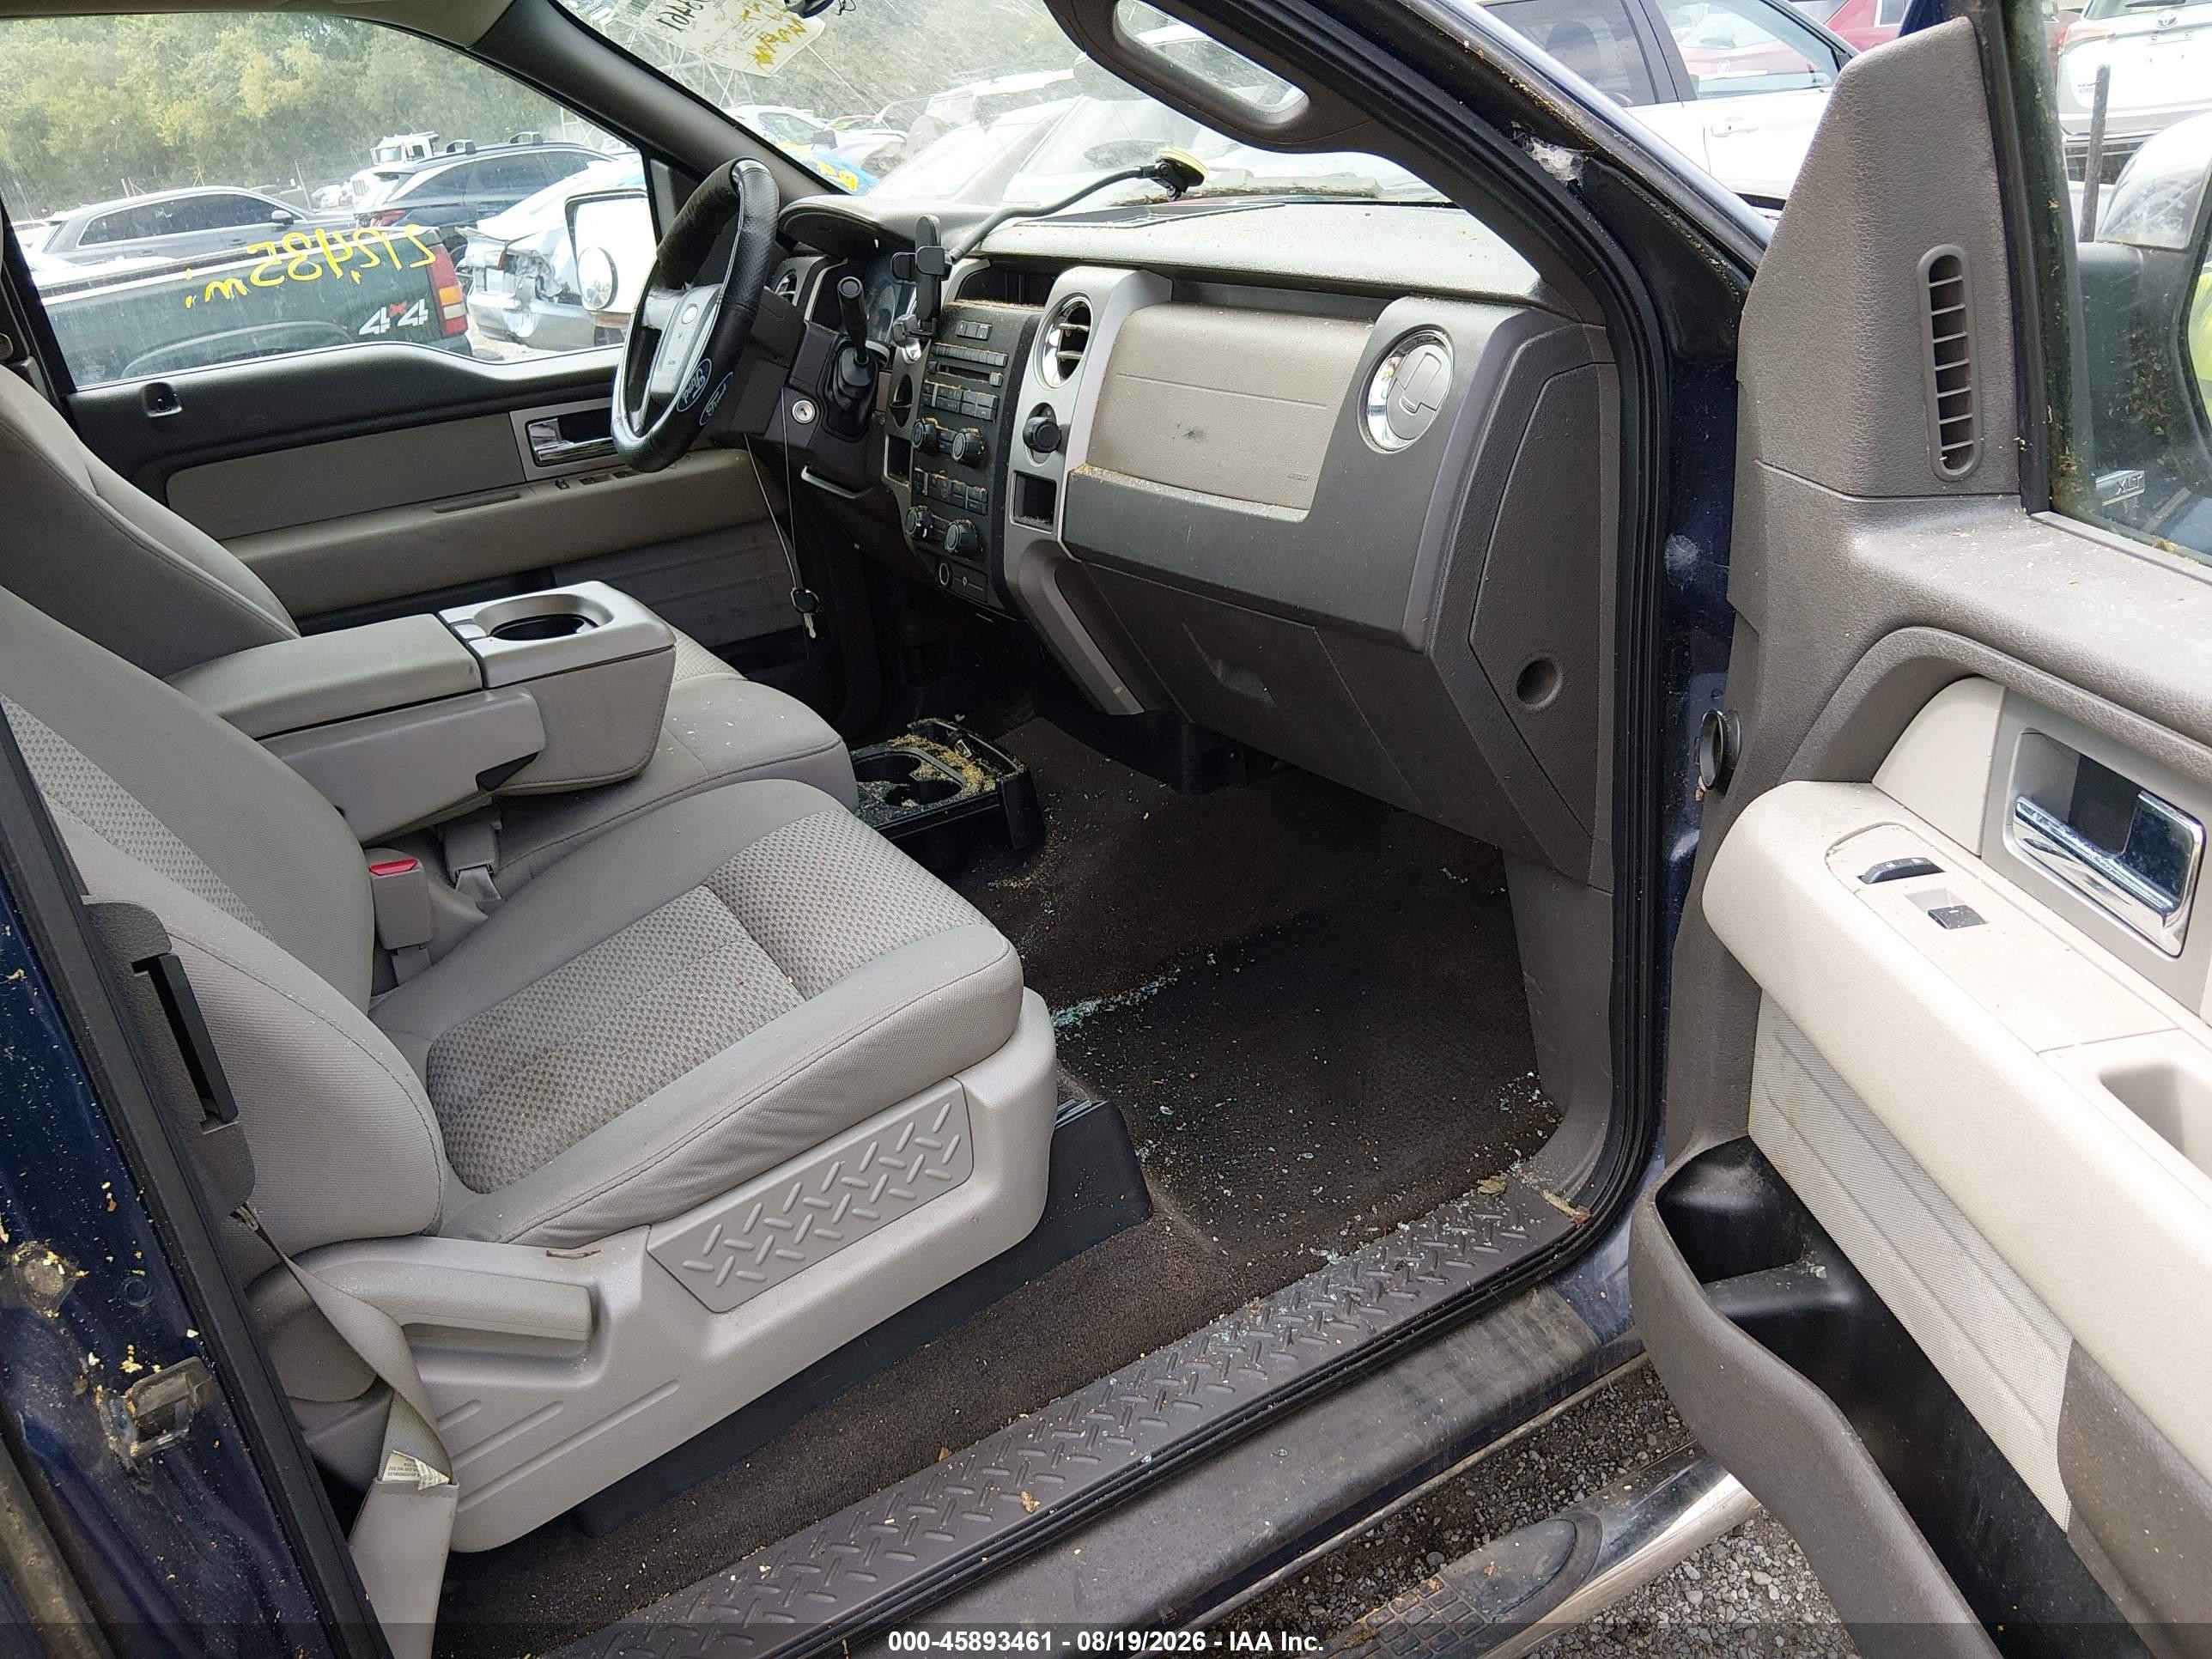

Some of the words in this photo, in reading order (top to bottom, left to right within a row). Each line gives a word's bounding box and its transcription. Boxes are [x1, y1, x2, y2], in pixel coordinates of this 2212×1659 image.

[682, 368, 706, 404] Ford
[706, 383, 727, 416] Ford
[2115, 474, 2143, 495] XLT
